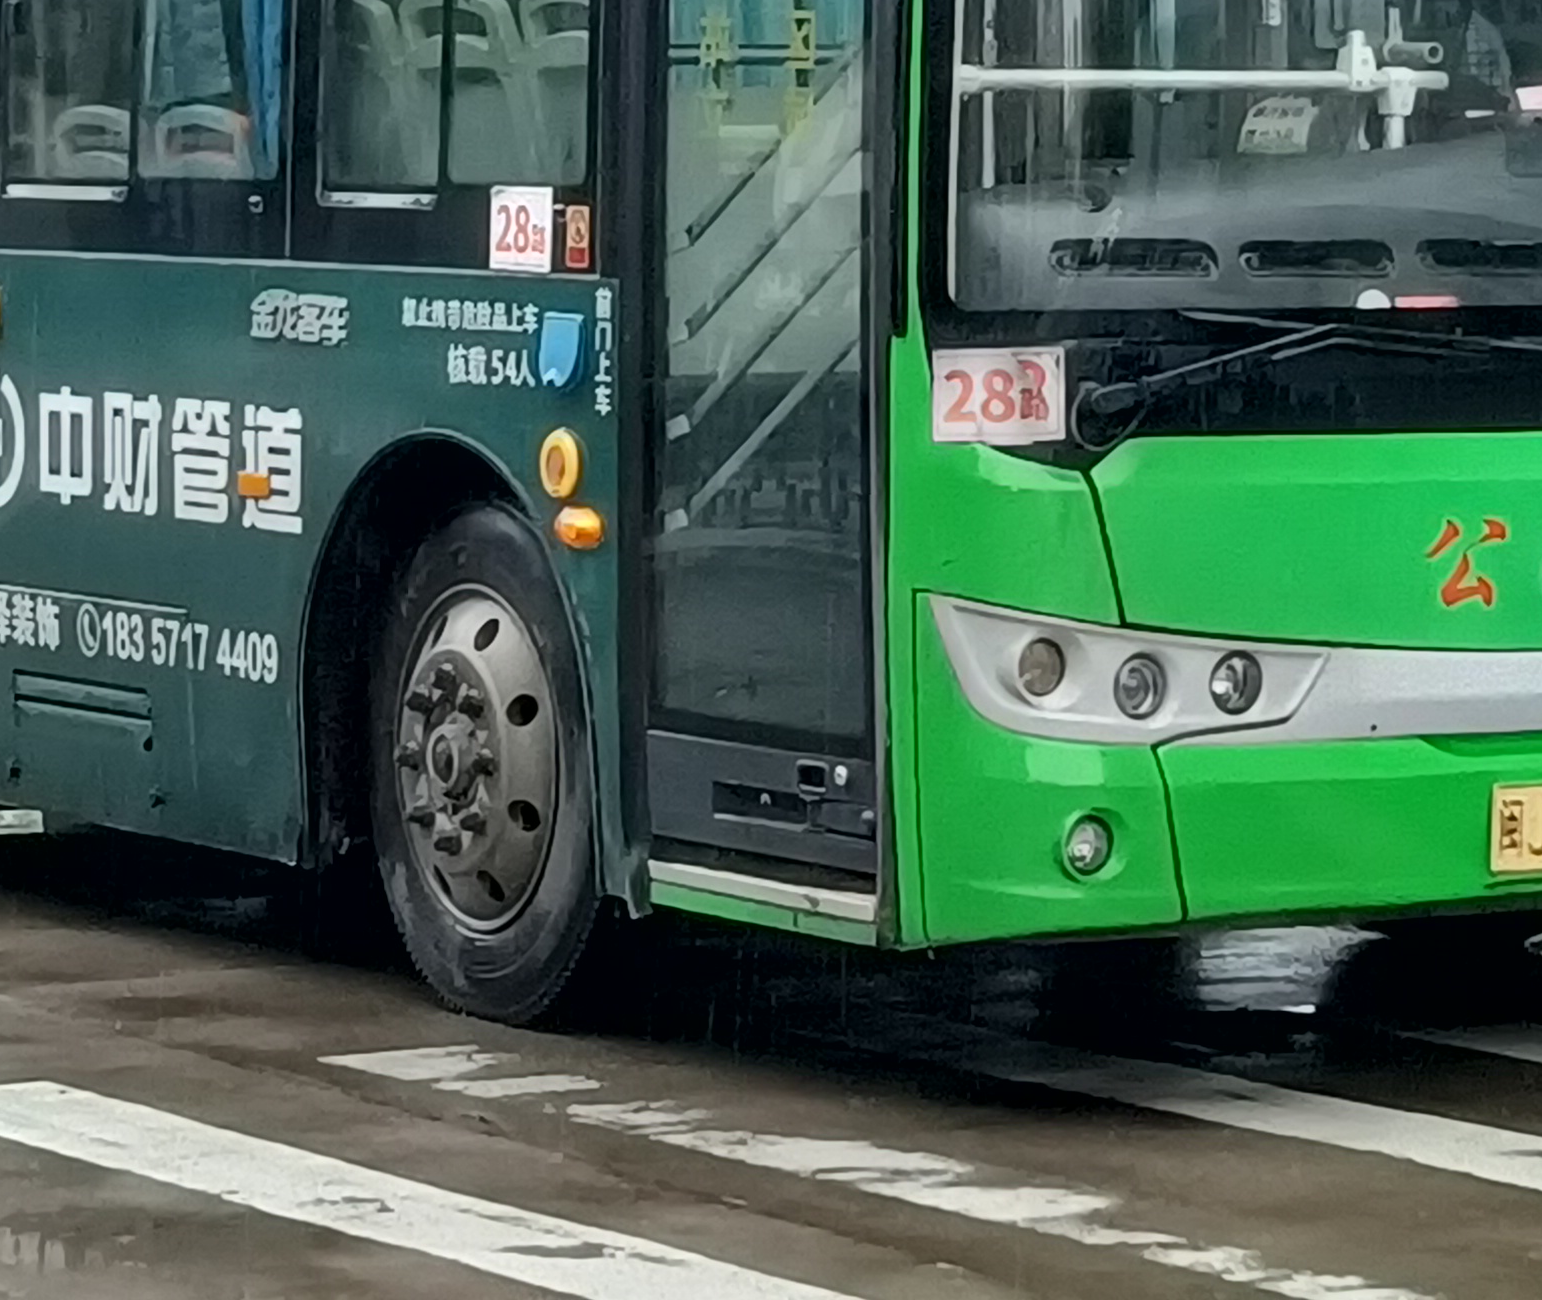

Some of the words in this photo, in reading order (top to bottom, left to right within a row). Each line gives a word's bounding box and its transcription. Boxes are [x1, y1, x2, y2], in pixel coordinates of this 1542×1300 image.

[37, 385, 304, 535] 中财管道
[101, 610, 145, 662] 183
[150, 617, 209, 671] 5717
[215, 627, 279, 684] 4409
